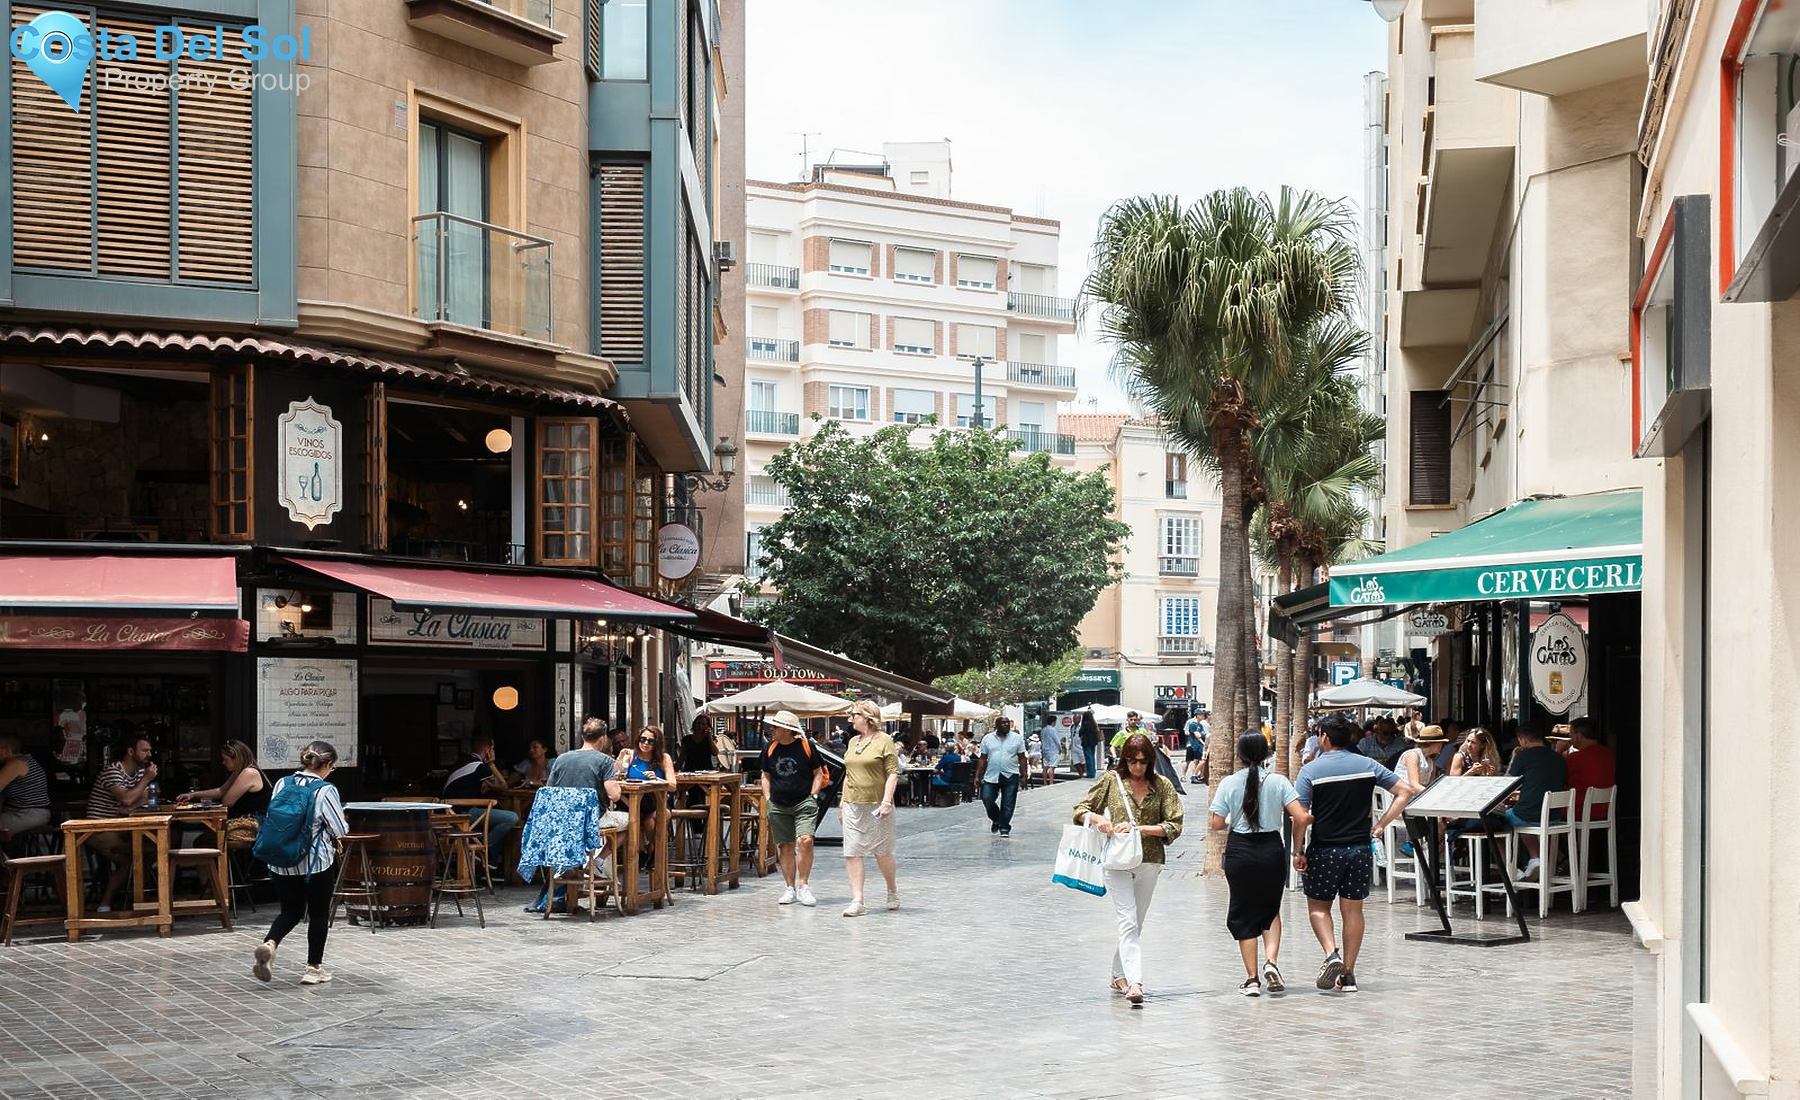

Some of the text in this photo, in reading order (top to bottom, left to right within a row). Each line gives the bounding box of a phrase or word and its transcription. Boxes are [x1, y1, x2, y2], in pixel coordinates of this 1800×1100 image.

[297, 437, 325, 449] VINOS
[288, 446, 333, 460] ESCOGIDOS
[1359, 576, 1379, 592] LOS
[1350, 586, 1386, 603] GATOS
[1412, 616, 1446, 628] GATOS
[1421, 608, 1439, 620] LOS
[407, 611, 441, 638] La
[81, 624, 109, 643] La
[1547, 635, 1569, 651] LOS
[1536, 646, 1578, 665] GATOS
[763, 668, 825, 679] OLD TOWN
[1335, 666, 1356, 685] P
[280, 687, 300, 696] ALGO
[558, 678, 567, 746] TAPAS
[411, 865, 426, 878] 27
